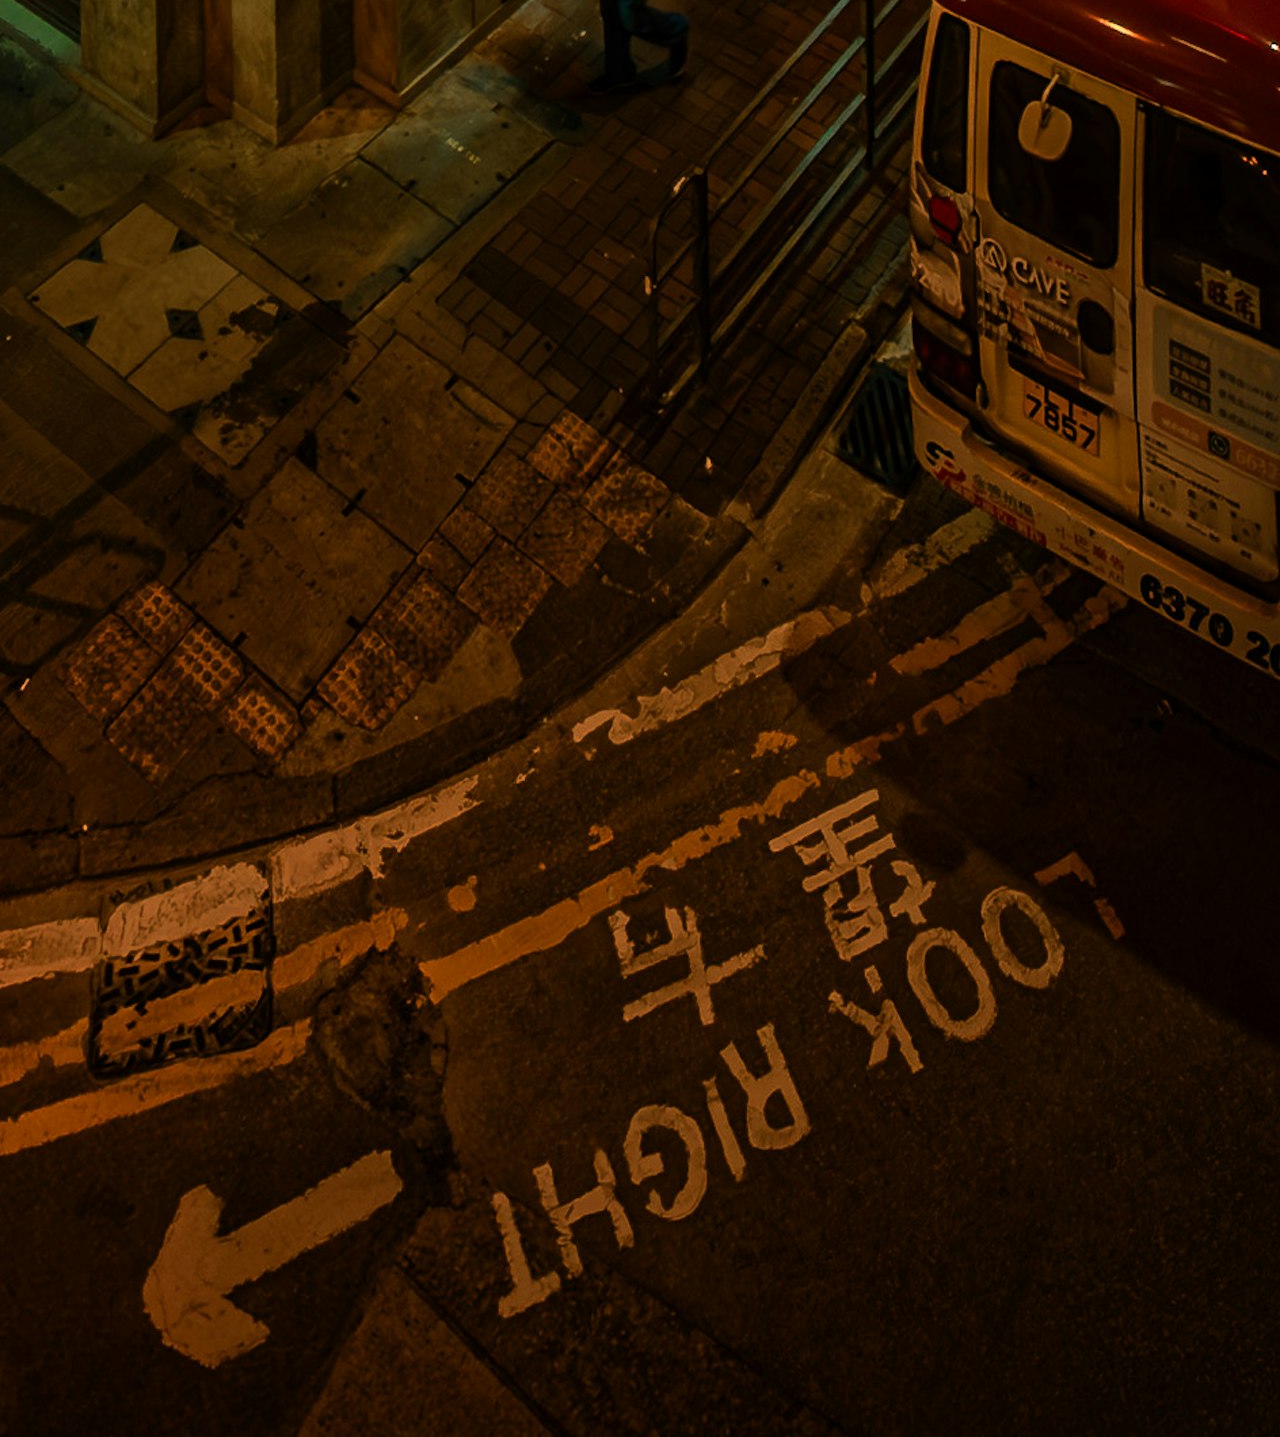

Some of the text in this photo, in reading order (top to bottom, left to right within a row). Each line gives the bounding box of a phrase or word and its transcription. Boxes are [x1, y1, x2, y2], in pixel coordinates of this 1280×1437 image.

[1011, 256, 1071, 306] CAVE
[1207, 279, 1257, 324] 旺角
[1025, 394, 1096, 451] 7857
[1139, 573, 1235, 646] 6370
[492, 1023, 812, 1319] RIGHT
